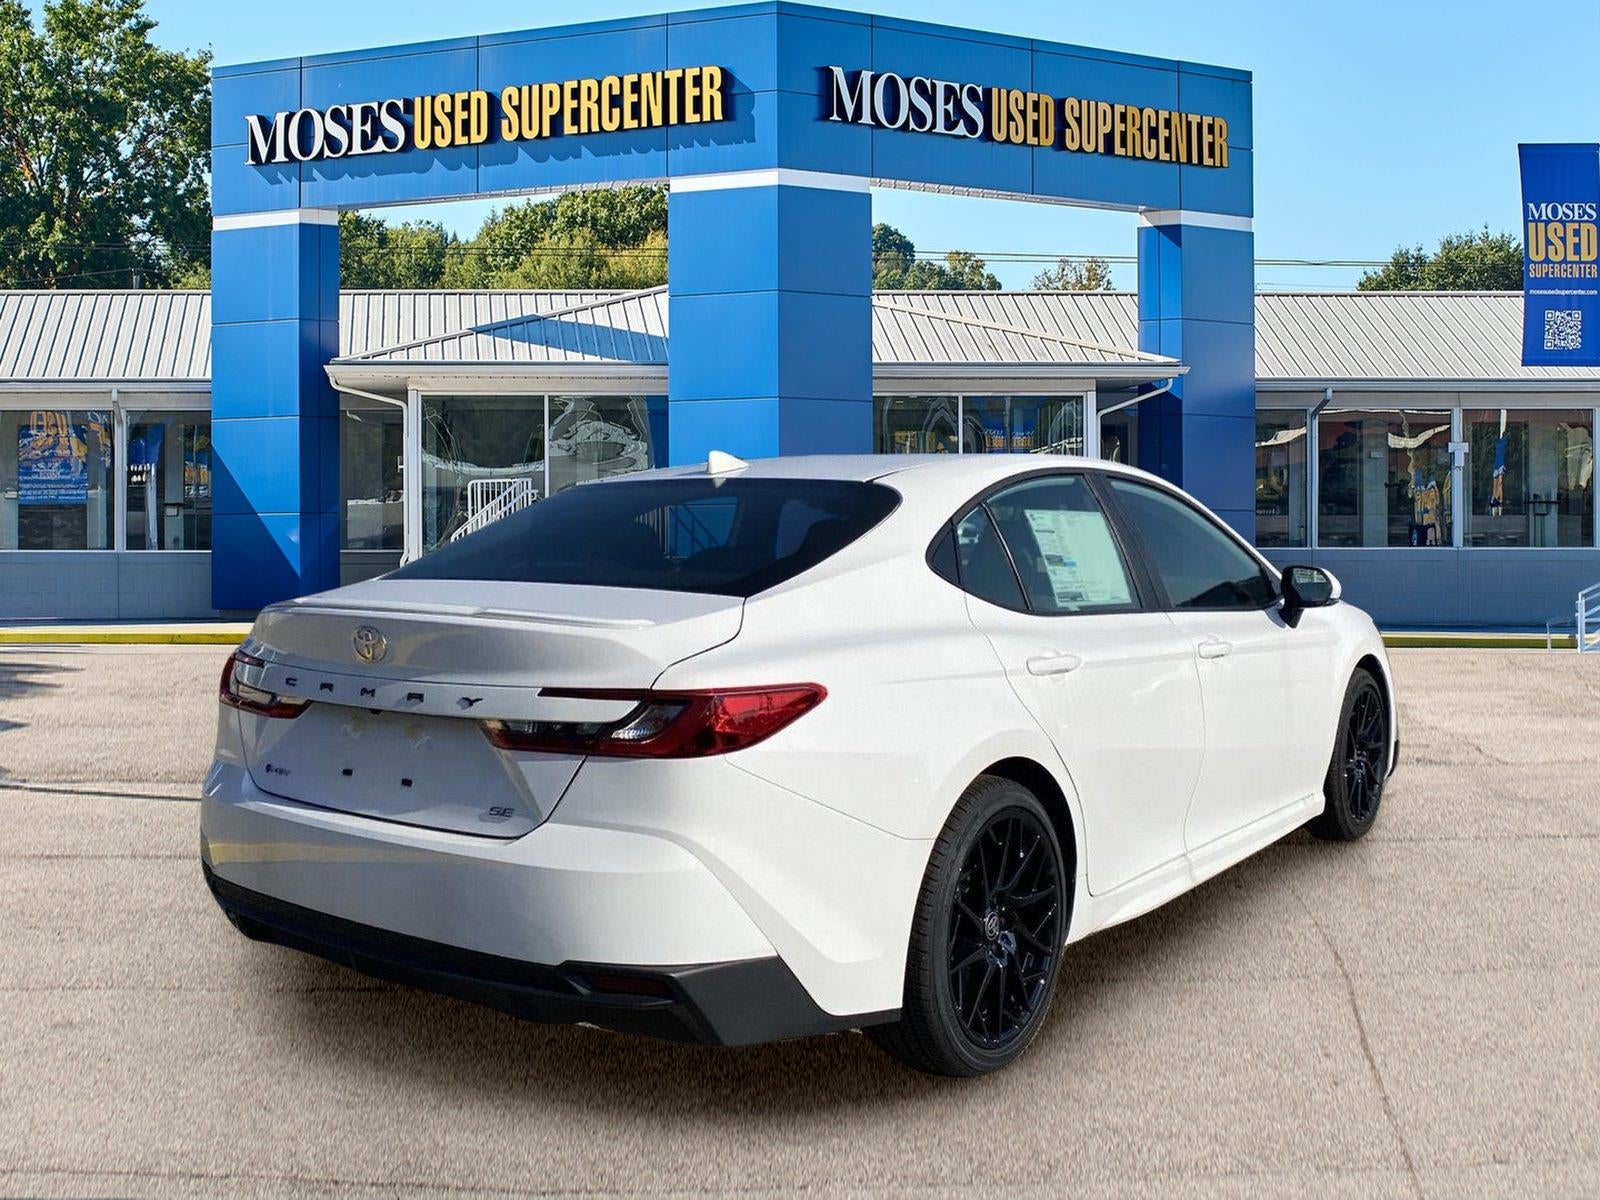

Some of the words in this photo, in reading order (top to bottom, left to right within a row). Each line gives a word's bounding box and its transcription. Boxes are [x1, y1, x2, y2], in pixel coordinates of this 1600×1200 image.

[244, 98, 407, 166] MOSES
[413, 90, 489, 150] USED
[500, 65, 724, 142] SUPERCENTER
[828, 65, 985, 139] MOSES
[990, 87, 1056, 147] USED
[1064, 97, 1230, 168] SUPERCENTER
[1527, 202, 1597, 221] MOSES
[1528, 222, 1597, 262] USED
[1529, 263, 1597, 278] SUPERCENTER
[285, 677, 484, 709] CAMRY
[489, 806, 515, 818] SE
